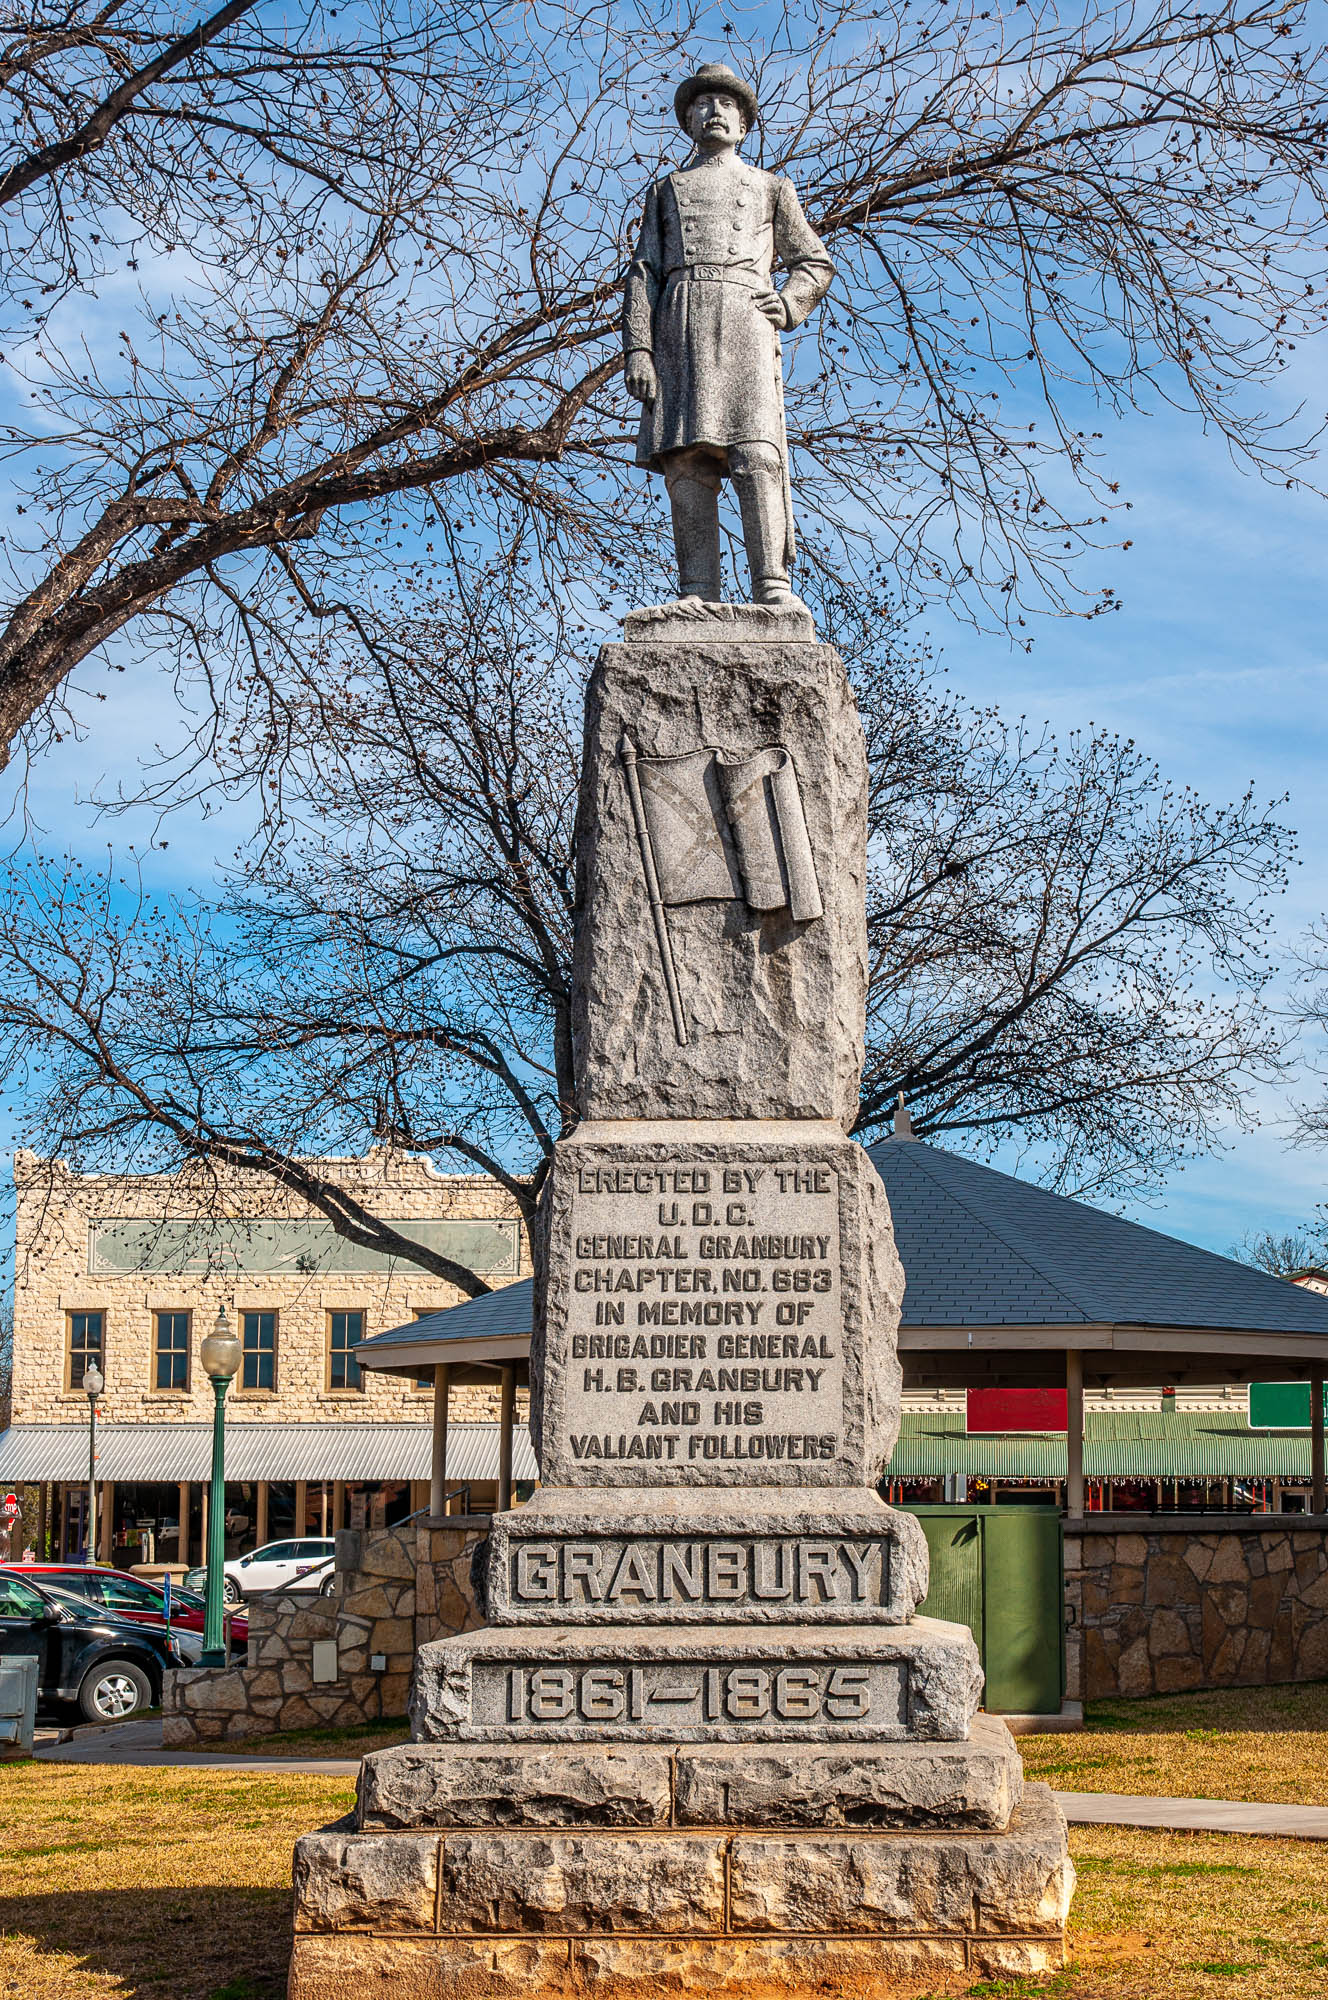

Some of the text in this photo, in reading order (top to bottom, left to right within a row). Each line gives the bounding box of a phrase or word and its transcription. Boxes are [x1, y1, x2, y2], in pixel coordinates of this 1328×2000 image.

[578, 1167, 831, 1194] ERECTED BY THE
[575, 1234, 831, 1260] GENERAL GRANBURY
[772, 1268, 833, 1292] 683
[595, 1301, 815, 1326] IN MEMORY OF
[572, 1334, 836, 1360] BRIGADIER GENERAL
[650, 1367, 827, 1393] GRANBURY
[637, 1401, 764, 1426] AND HIS
[569, 1433, 837, 1461] VALIANT FOLLOWERS
[516, 1543, 882, 1600] GRANBURY
